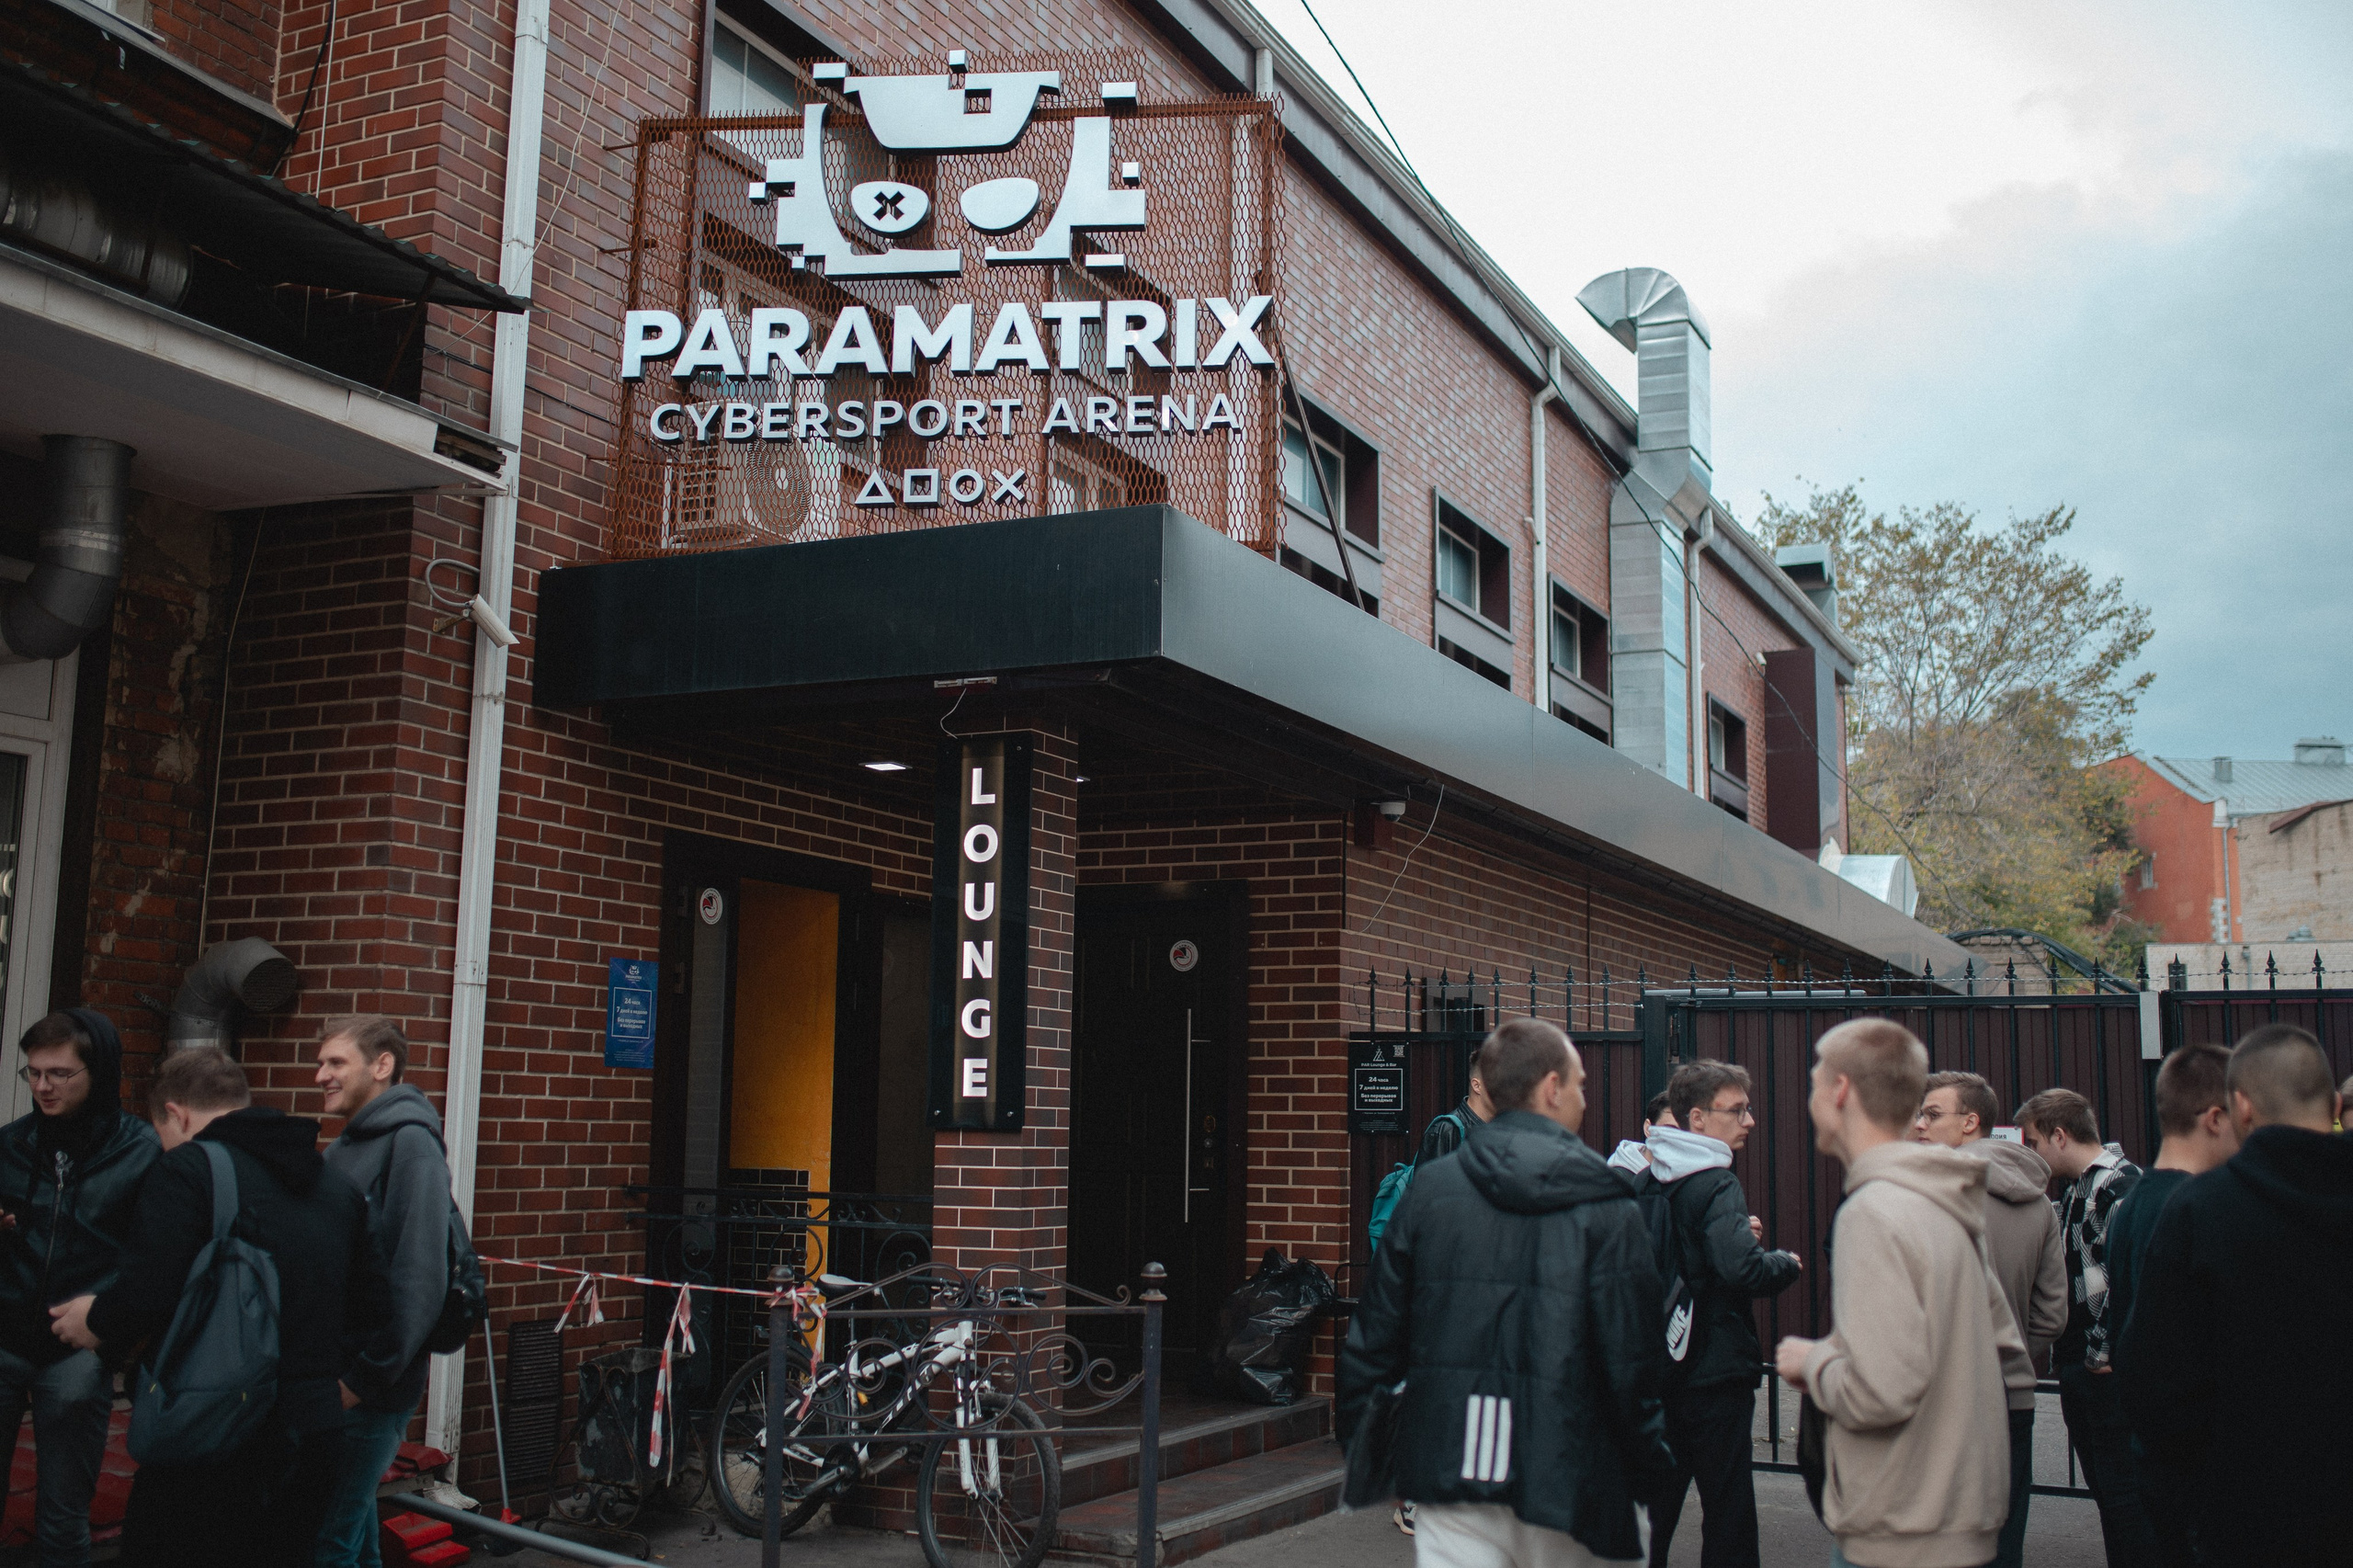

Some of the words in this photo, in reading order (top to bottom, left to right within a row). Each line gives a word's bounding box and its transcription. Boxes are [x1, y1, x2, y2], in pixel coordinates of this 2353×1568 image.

[622, 295, 1276, 381] PARAMATRIX
[650, 398, 1023, 443] CYBERSPORT
[1041, 392, 1241, 436] ARENA
[961, 767, 999, 1097] LOUNGE
[1666, 1304, 1688, 1349] NIKE
